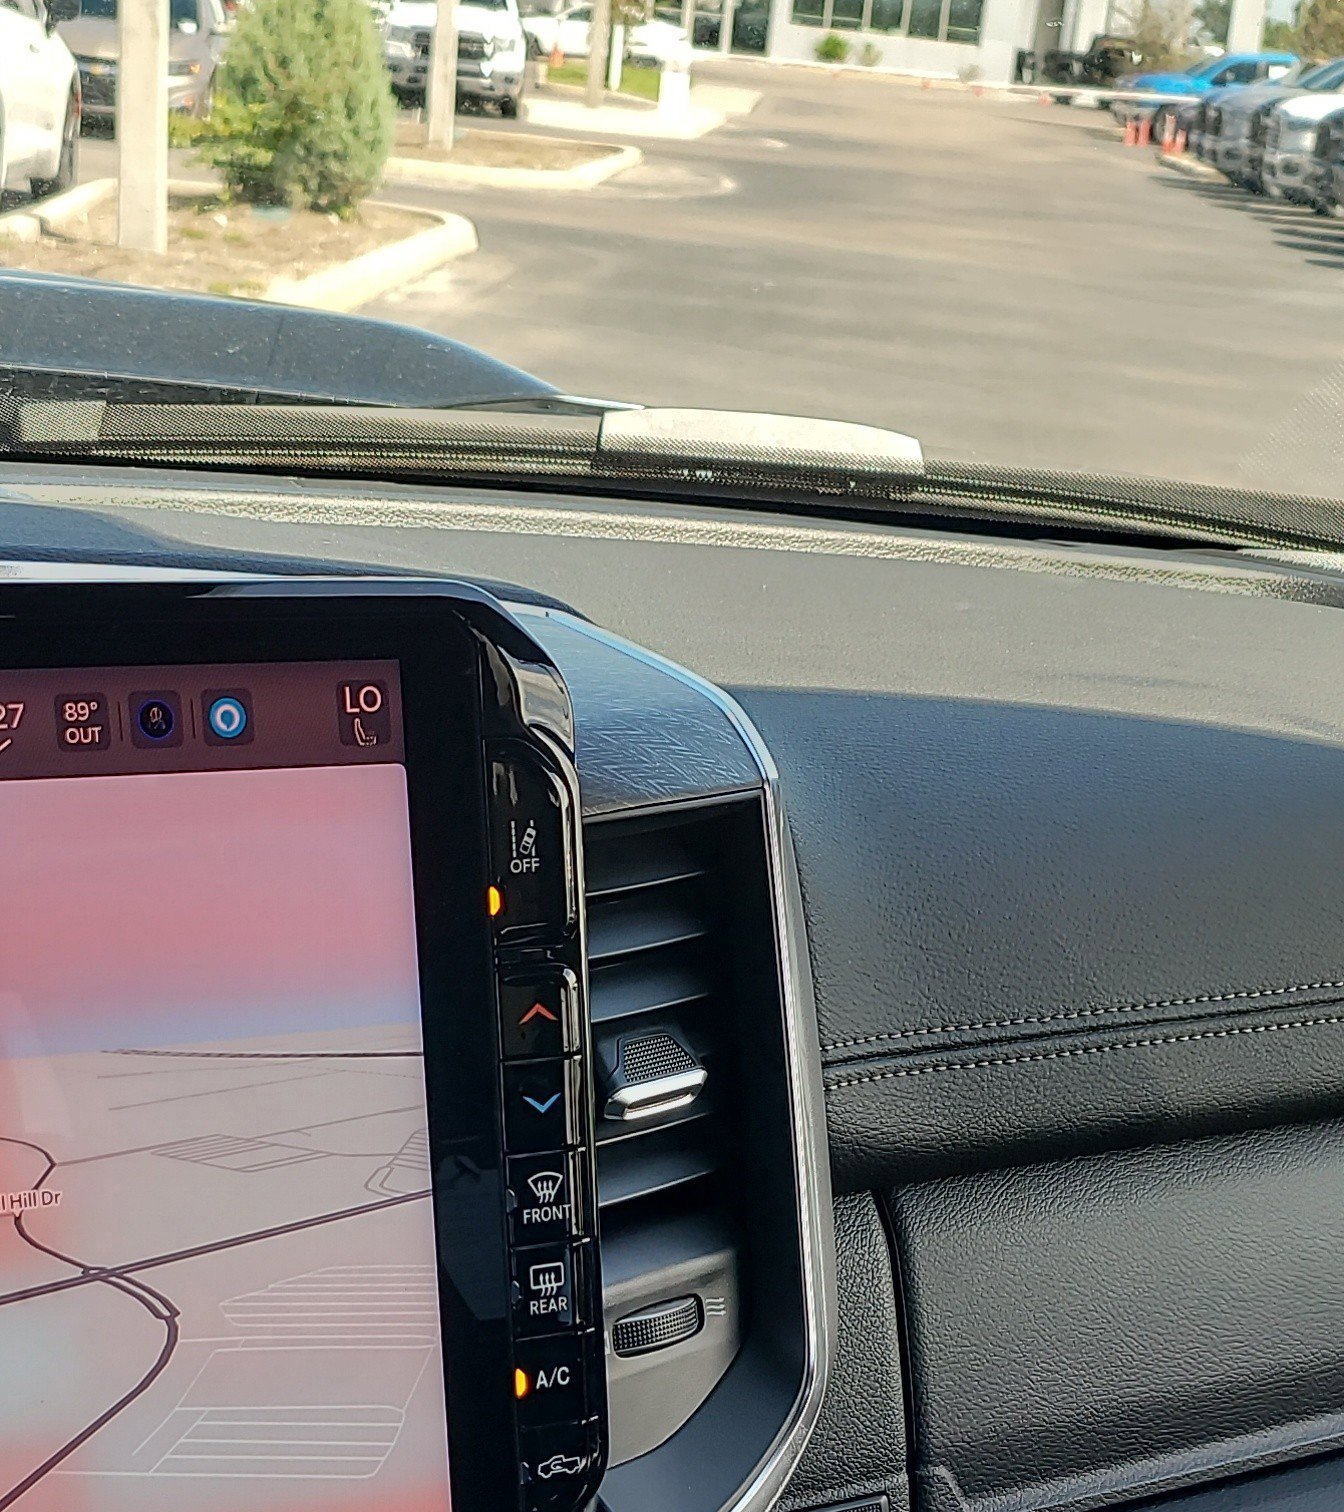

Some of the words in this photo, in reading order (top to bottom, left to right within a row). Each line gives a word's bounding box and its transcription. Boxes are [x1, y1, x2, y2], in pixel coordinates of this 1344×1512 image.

[345, 685, 382, 713] LO
[63, 702, 98, 722] 89°
[66, 726, 102, 744] OUT
[510, 857, 540, 874] OFF
[9, 1192, 38, 1210] Hill
[41, 1189, 61, 1206] Dr
[522, 1203, 572, 1225] FRONT
[529, 1296, 569, 1315] REAR
[535, 1366, 570, 1389] A/C
